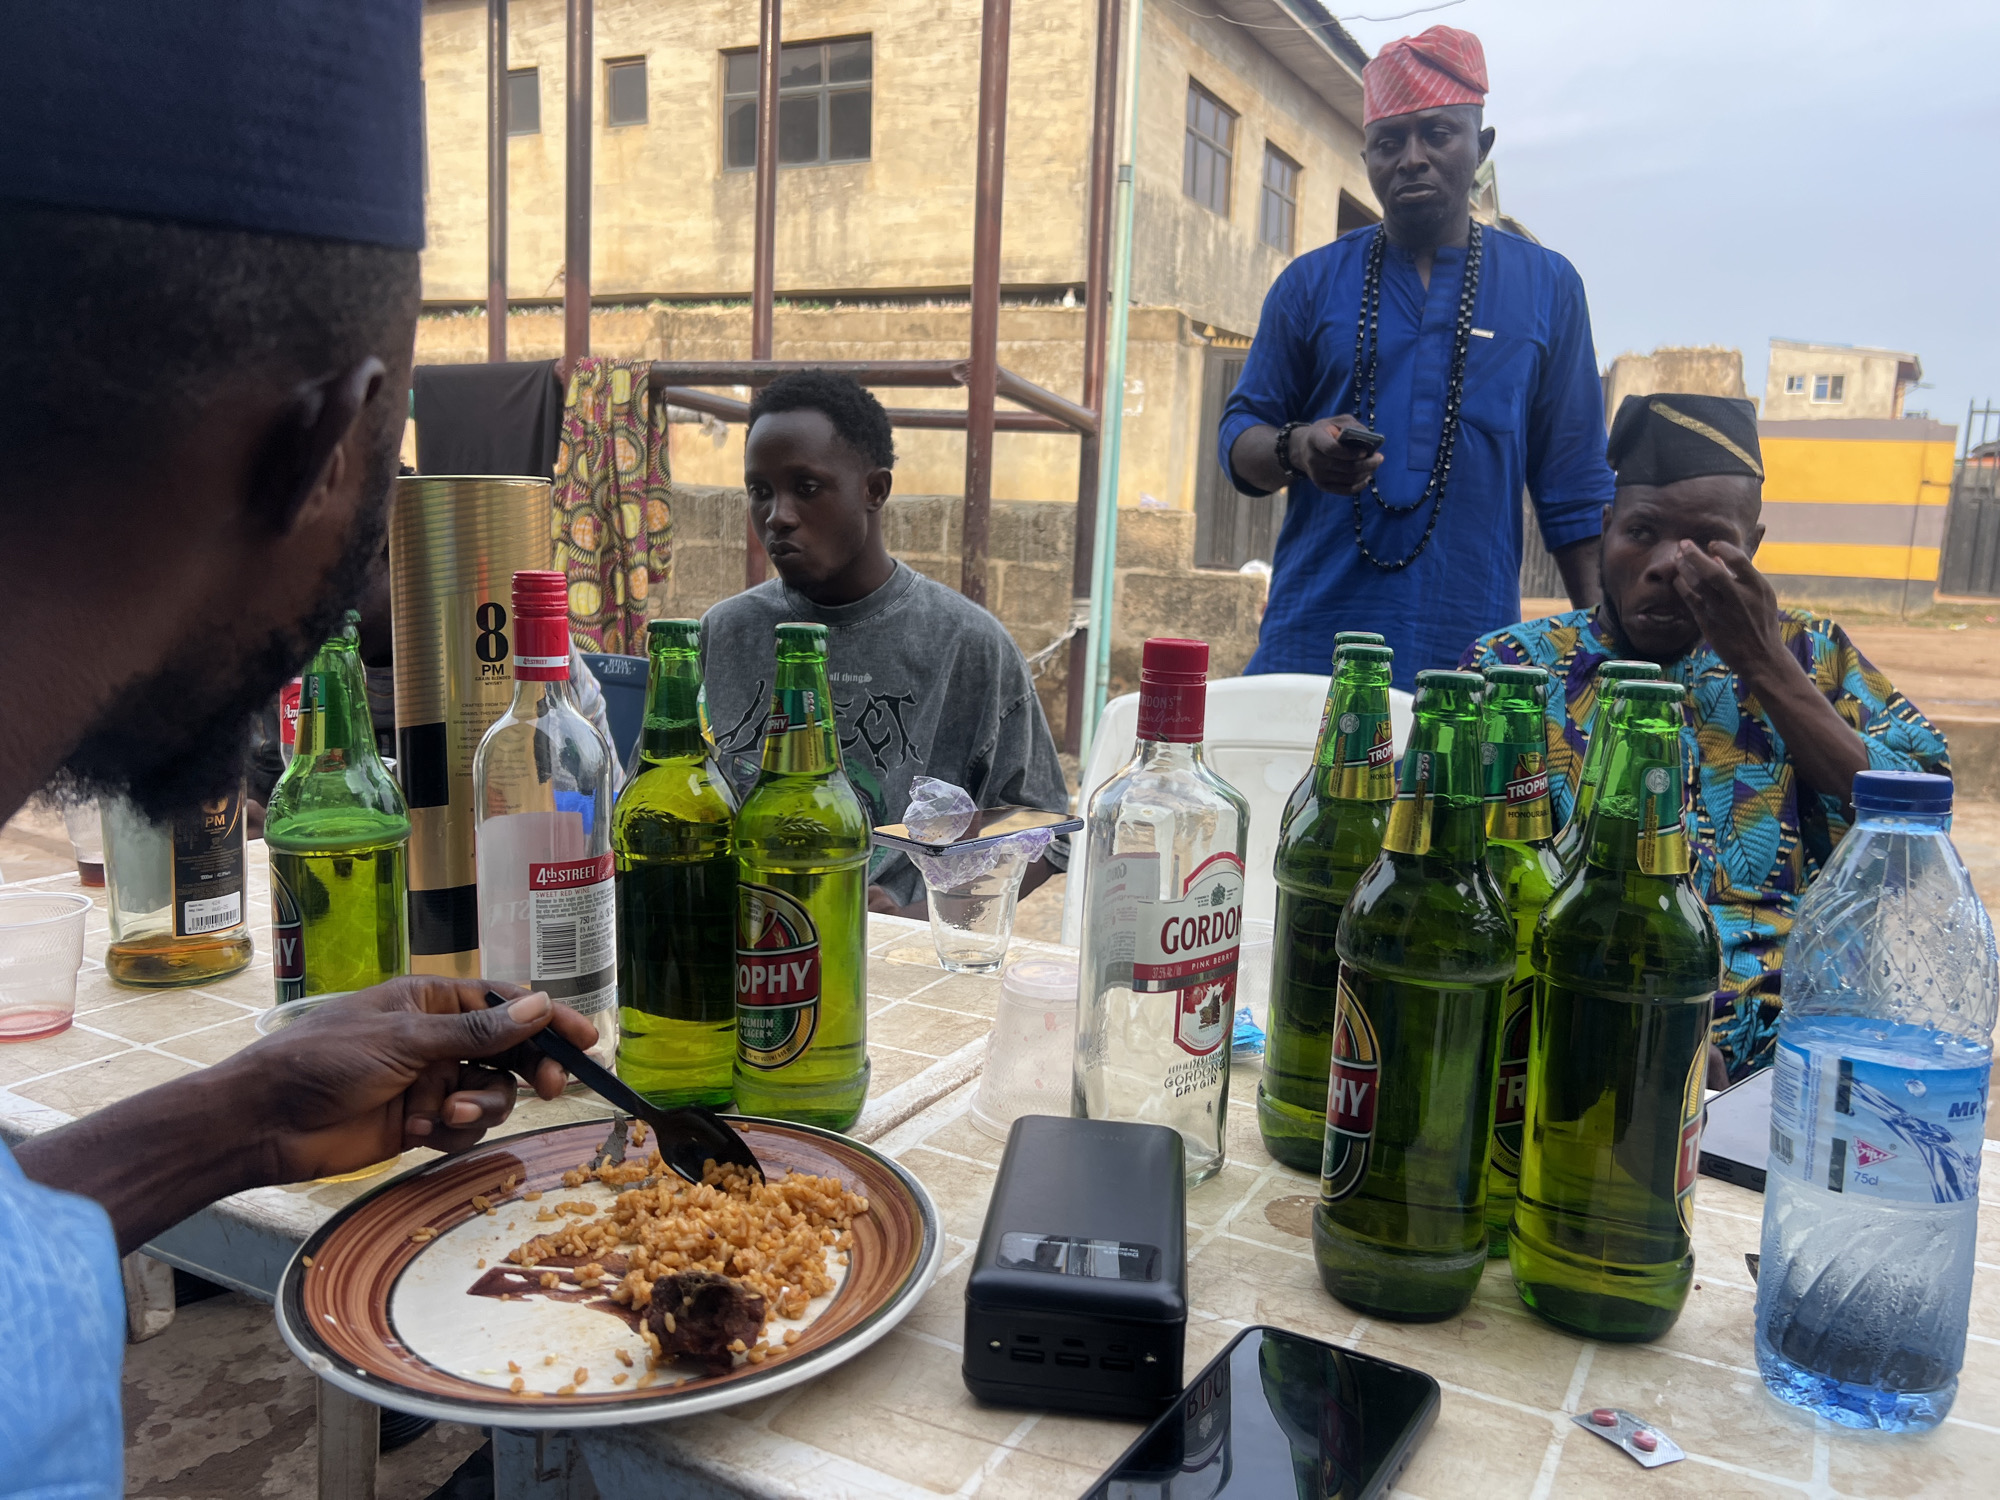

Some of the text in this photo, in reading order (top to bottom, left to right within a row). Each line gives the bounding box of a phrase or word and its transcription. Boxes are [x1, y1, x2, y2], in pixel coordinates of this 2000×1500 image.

[476, 602, 508, 662] 8
[481, 664, 505, 676] PM
[205, 814, 226, 828] PM
[574, 887, 591, 895] WINE
[1191, 951, 1234, 971] PINK BERRY
[740, 1016, 774, 1029] PREMIUM
[744, 1028, 765, 1039] LAGER
[1176, 1074, 1217, 1098] DRY GIN
[1853, 1170, 1880, 1187] 75cl
